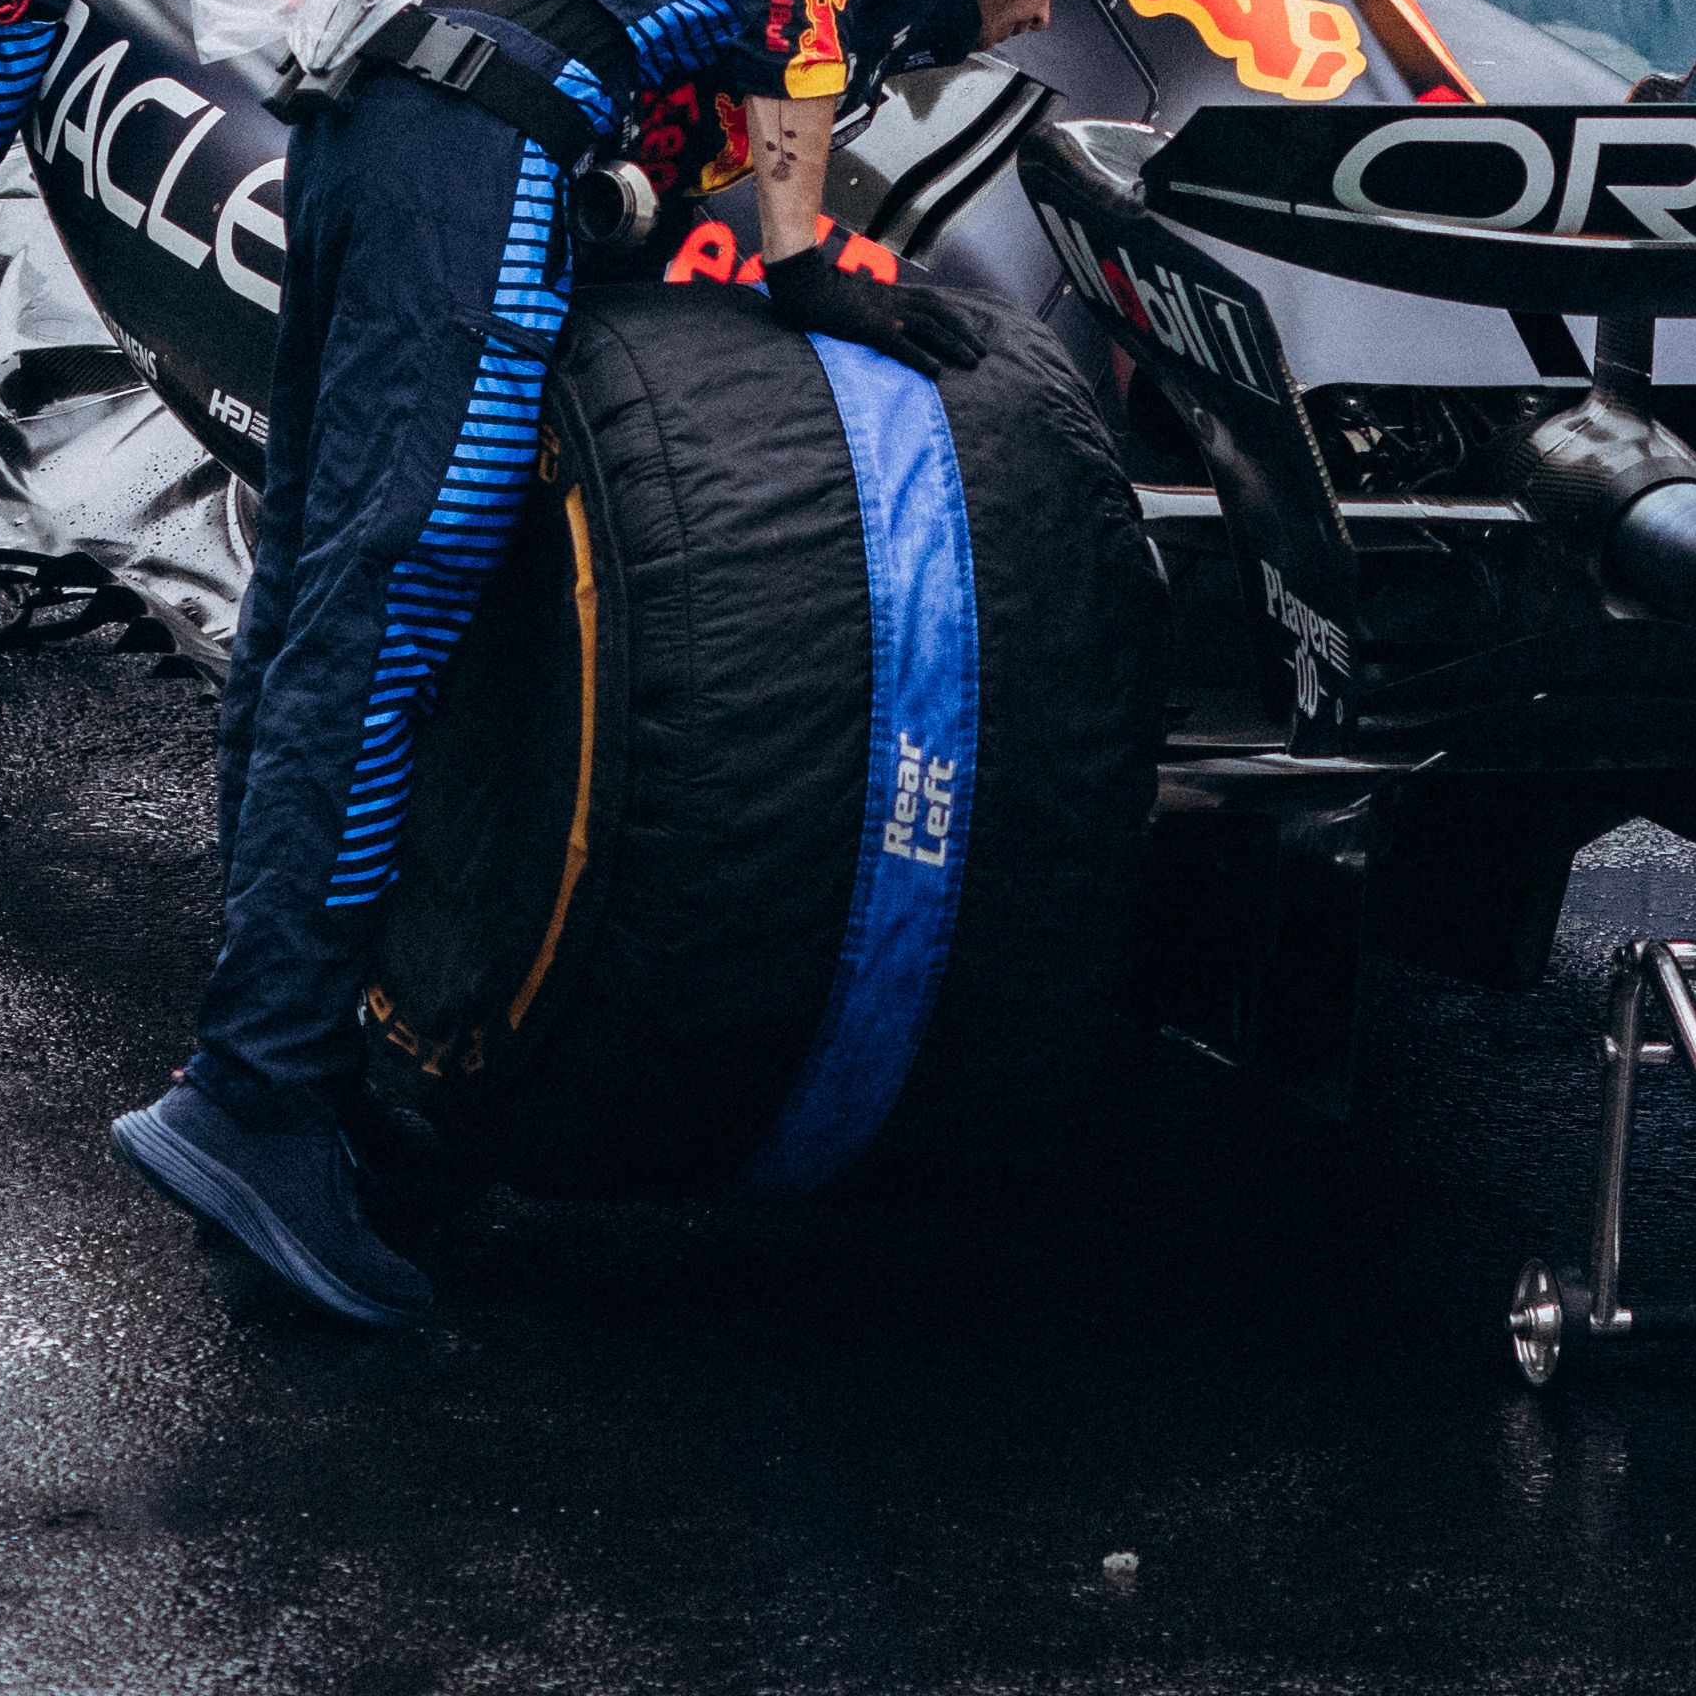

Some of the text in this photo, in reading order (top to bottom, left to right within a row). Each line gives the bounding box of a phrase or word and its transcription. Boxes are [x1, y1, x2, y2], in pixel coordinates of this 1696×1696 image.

[1039, 202, 1221, 375] Mobil
[1260, 558, 1331, 661] Player
[883, 731, 922, 858] Rear
[915, 756, 957, 868] Left
